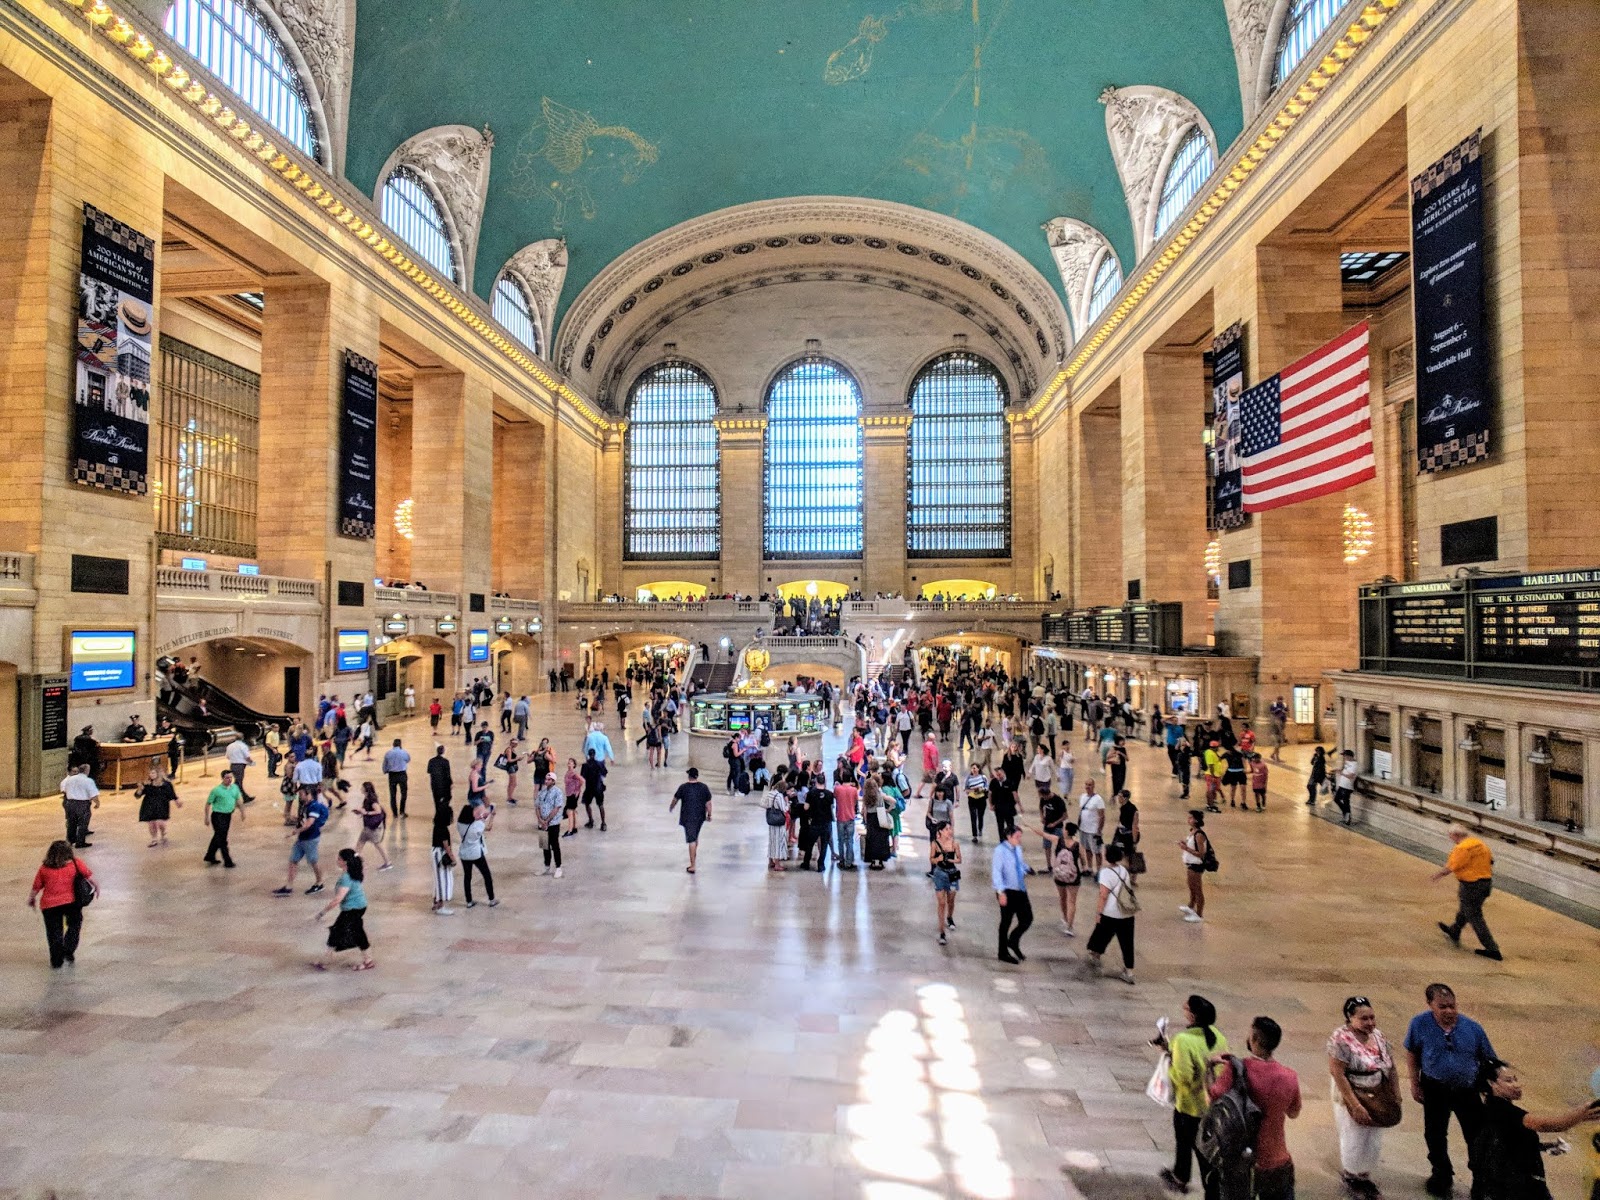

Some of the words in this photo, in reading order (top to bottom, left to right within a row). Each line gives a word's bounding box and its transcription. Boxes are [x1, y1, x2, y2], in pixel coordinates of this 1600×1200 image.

[1437, 185, 1460, 206] YEARS
[1416, 202, 1452, 231] AMERICAN
[1453, 183, 1478, 206] STYLE
[87, 249, 127, 273] AMERICAN
[127, 269, 150, 285] STYLE
[96, 244, 112, 257] 200
[112, 252, 135, 269] YEARS
[95, 263, 108, 274] THE
[108, 269, 142, 290] EXHIBITION
[1430, 334, 1463, 353] September
[1433, 326, 1454, 341] August
[1425, 355, 1457, 374] Vanderbilt
[1457, 347, 1472, 361] Hall
[1402, 582, 1451, 594] INFORMATION
[1523, 574, 1564, 585] HARLEM
[1565, 571, 1591, 582] LINE
[1478, 595, 1494, 603] TIME
[1515, 592, 1565, 602] DESTINATION
[155, 645, 171, 655] THE
[171, 631, 204, 647] METLIFE
[204, 626, 236, 637] BUILDING
[272, 629, 294, 640] STREET
